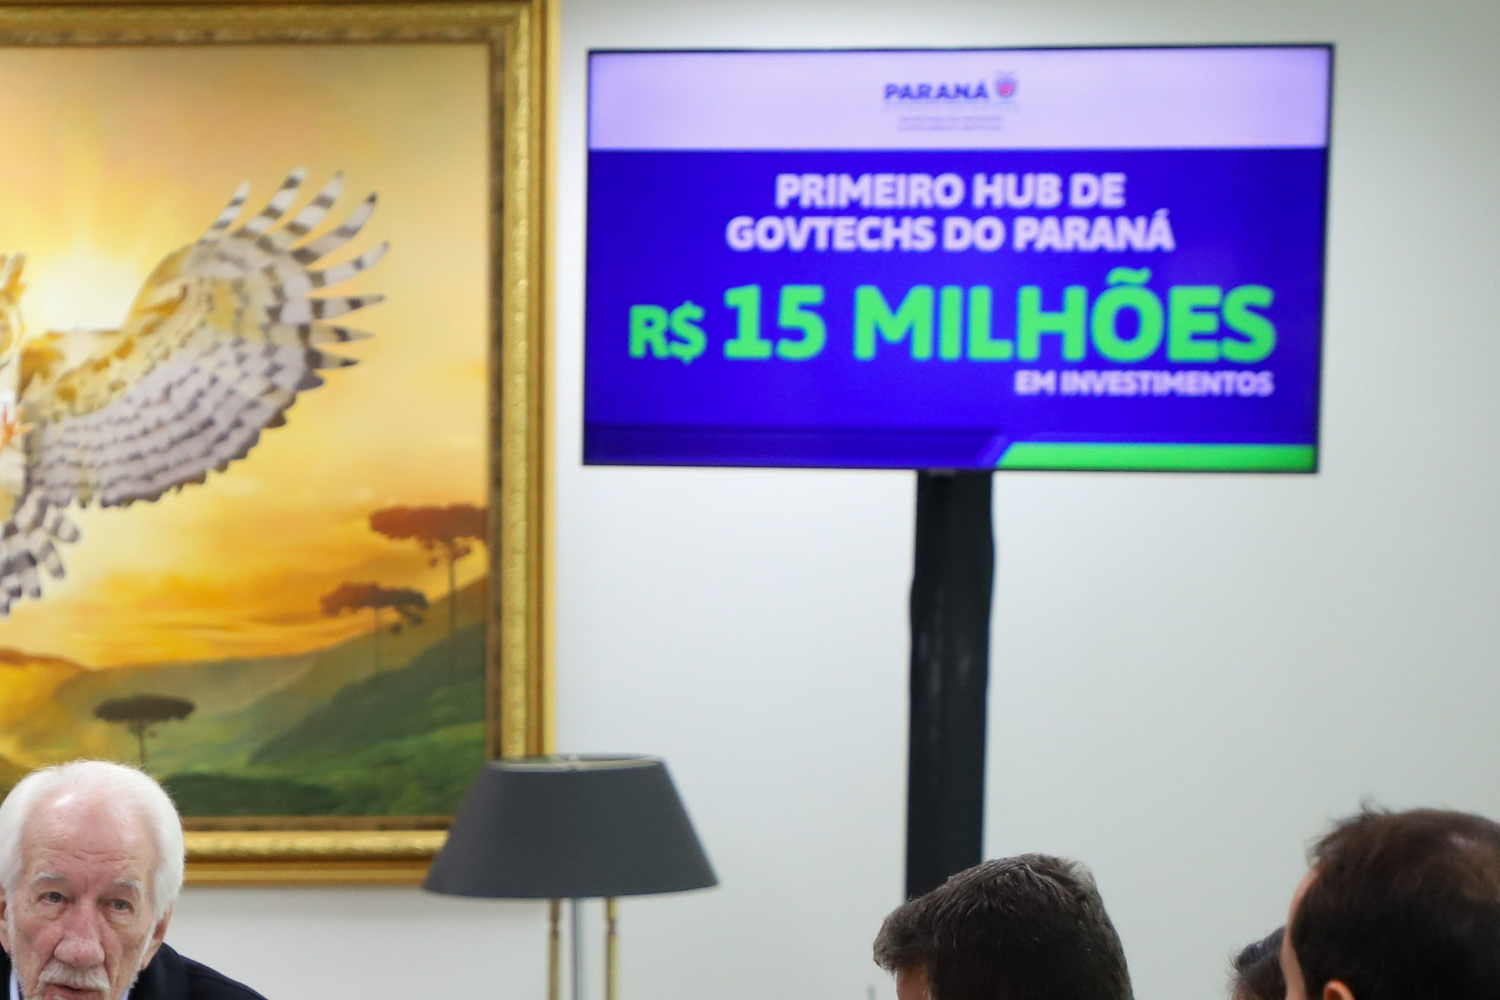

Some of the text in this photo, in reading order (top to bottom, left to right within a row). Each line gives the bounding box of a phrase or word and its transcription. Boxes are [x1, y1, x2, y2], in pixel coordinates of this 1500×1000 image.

[885, 80, 989, 99] PARANÁ
[775, 173, 1127, 209] PRIMEIRO HUB DE
[726, 209, 1175, 252] GOVTECHS DO PARANÁ
[629, 268, 1276, 364] R$ 15 MILHÕES
[1015, 370, 1274, 397] EM INVESTIMENTOS
